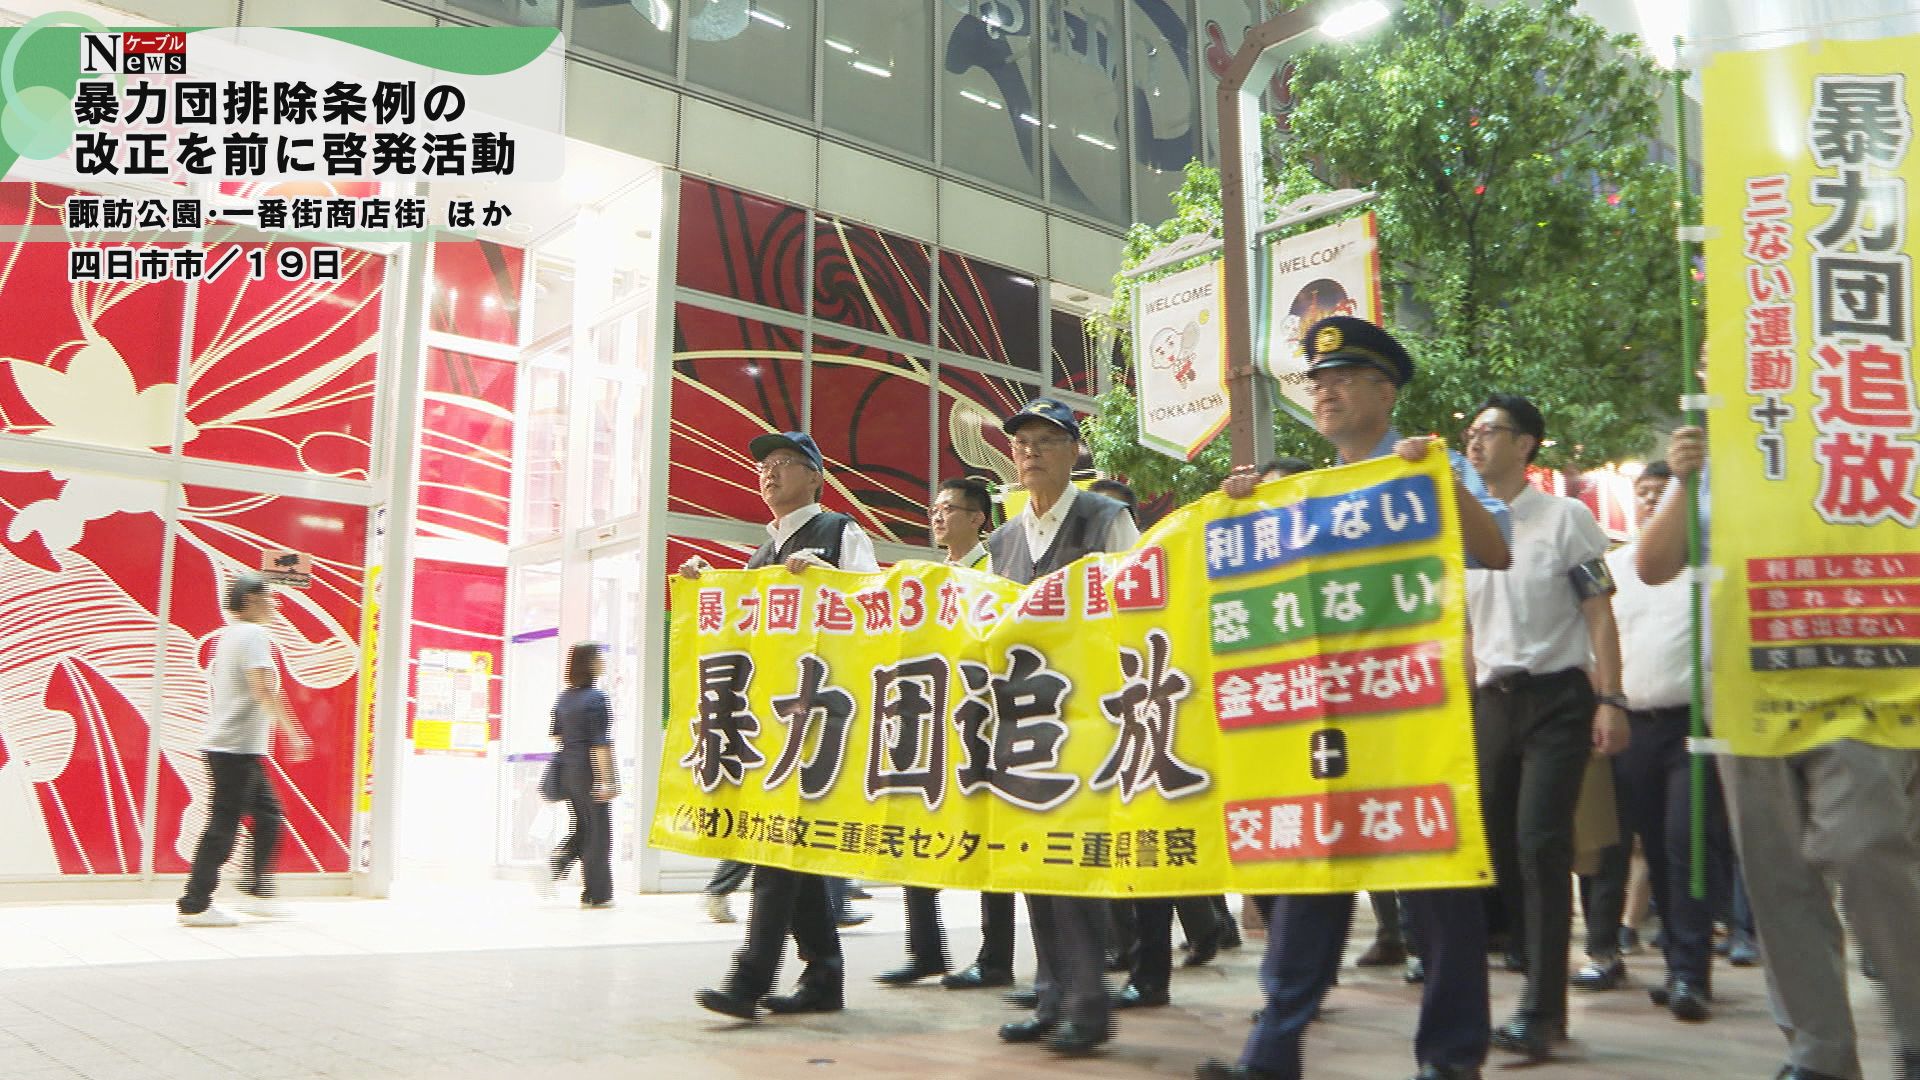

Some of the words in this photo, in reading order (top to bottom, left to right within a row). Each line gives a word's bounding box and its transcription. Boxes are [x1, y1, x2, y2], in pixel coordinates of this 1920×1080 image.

[1144, 283, 1212, 316] WELCOME
[1809, 74, 1919, 525] 暴力団追放
[1148, 393, 1224, 423] YOKKAICHI
[1206, 490, 1428, 571] 利用しない
[1210, 569, 1440, 645] 恐れない
[680, 628, 1210, 812] 暴力団追放
[1217, 650, 1436, 721] 金を出さない
[1226, 794, 1450, 853] 交際しない
